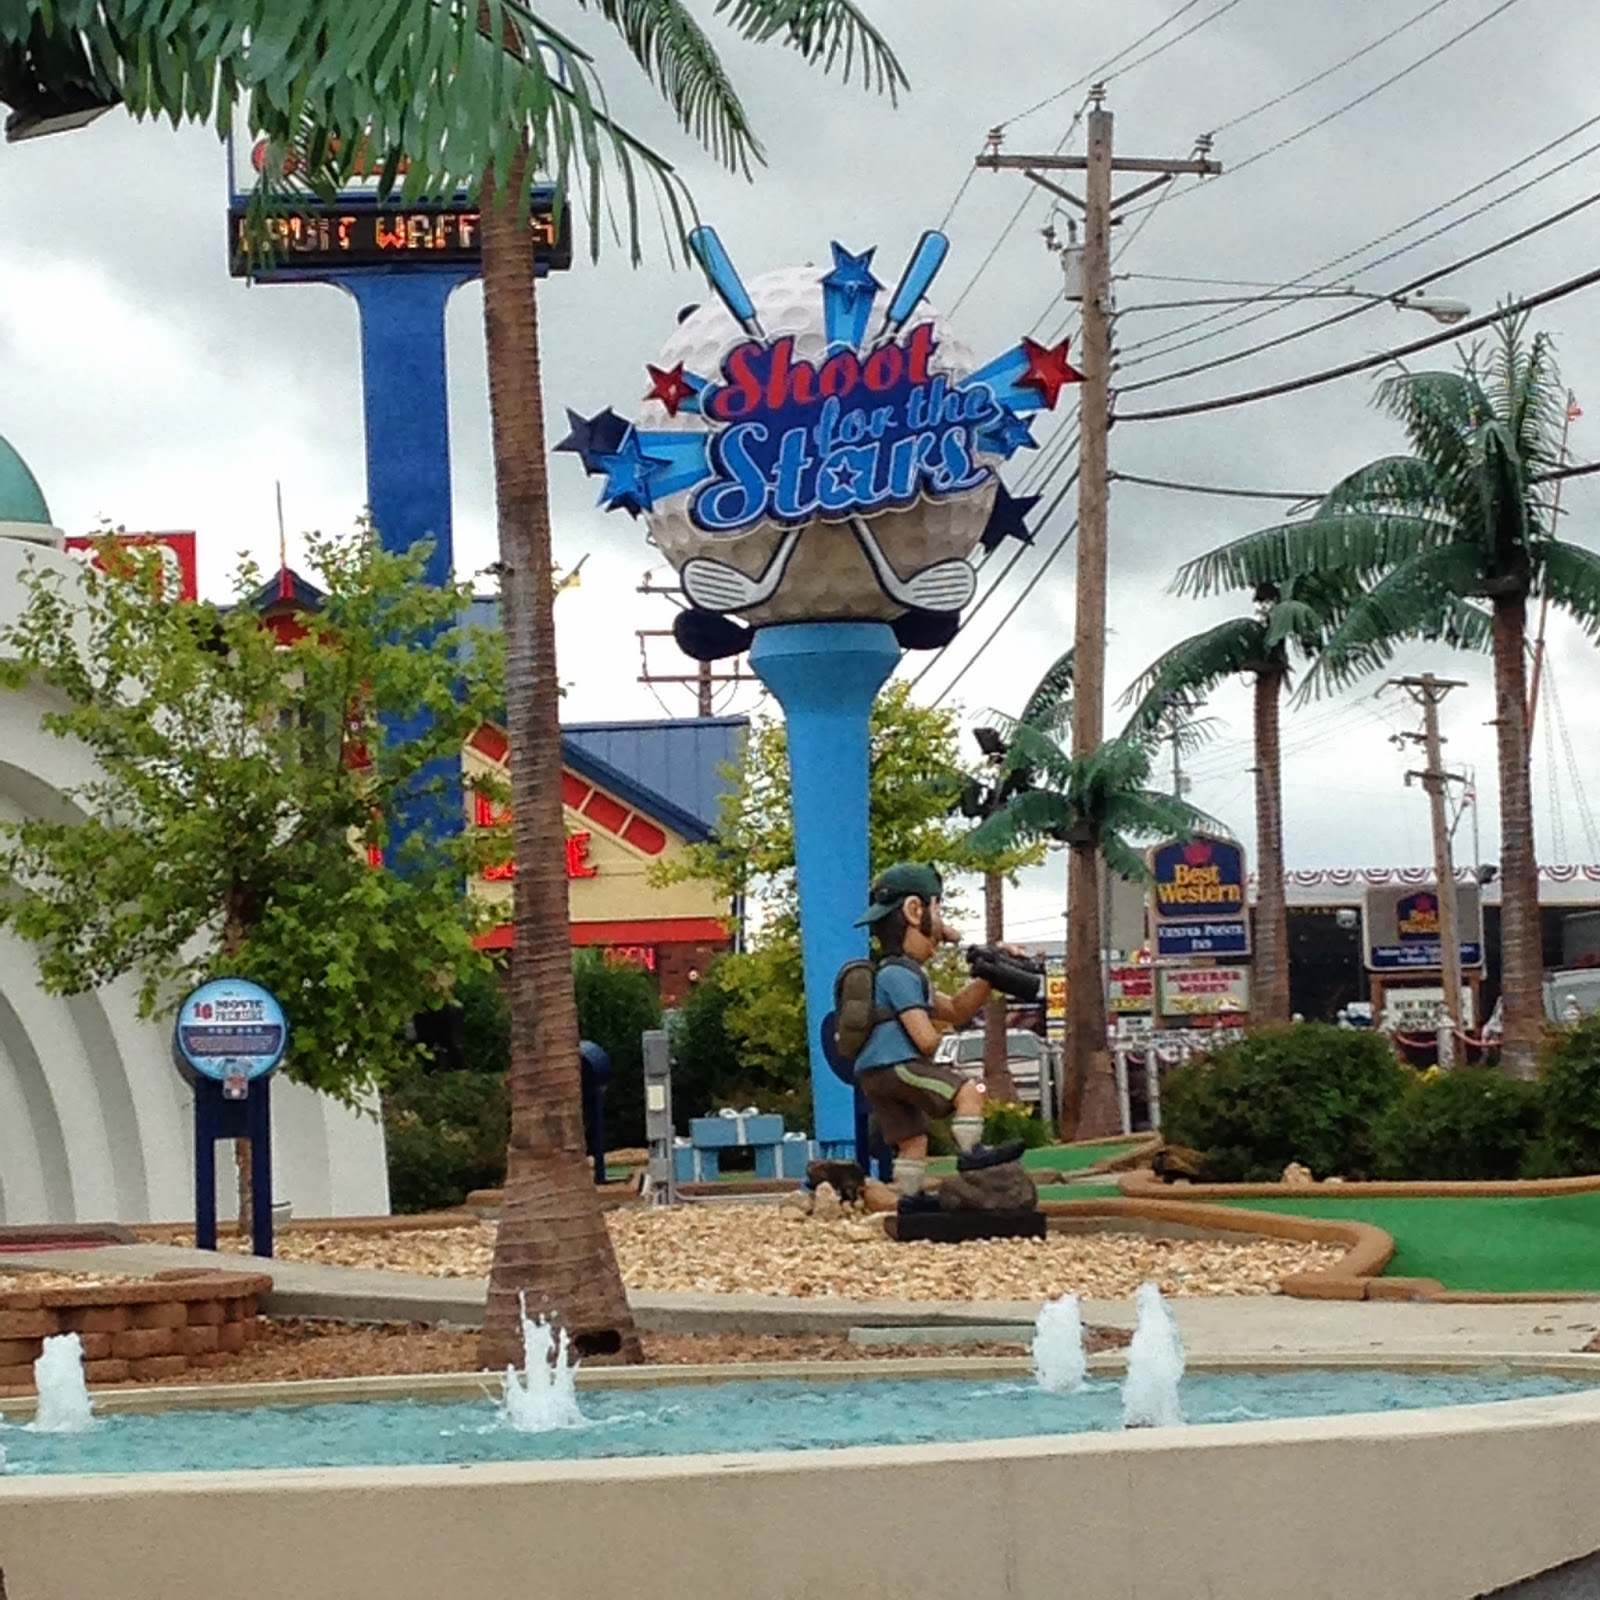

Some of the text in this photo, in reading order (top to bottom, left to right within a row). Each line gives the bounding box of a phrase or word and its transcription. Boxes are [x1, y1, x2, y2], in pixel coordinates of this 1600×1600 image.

[375, 214, 554, 250] WAFFS
[711, 322, 935, 418] Shoot
[812, 376, 994, 458] for the
[696, 422, 986, 530] Stars
[1158, 882, 1241, 904] Western
[1174, 863, 1220, 886] Best
